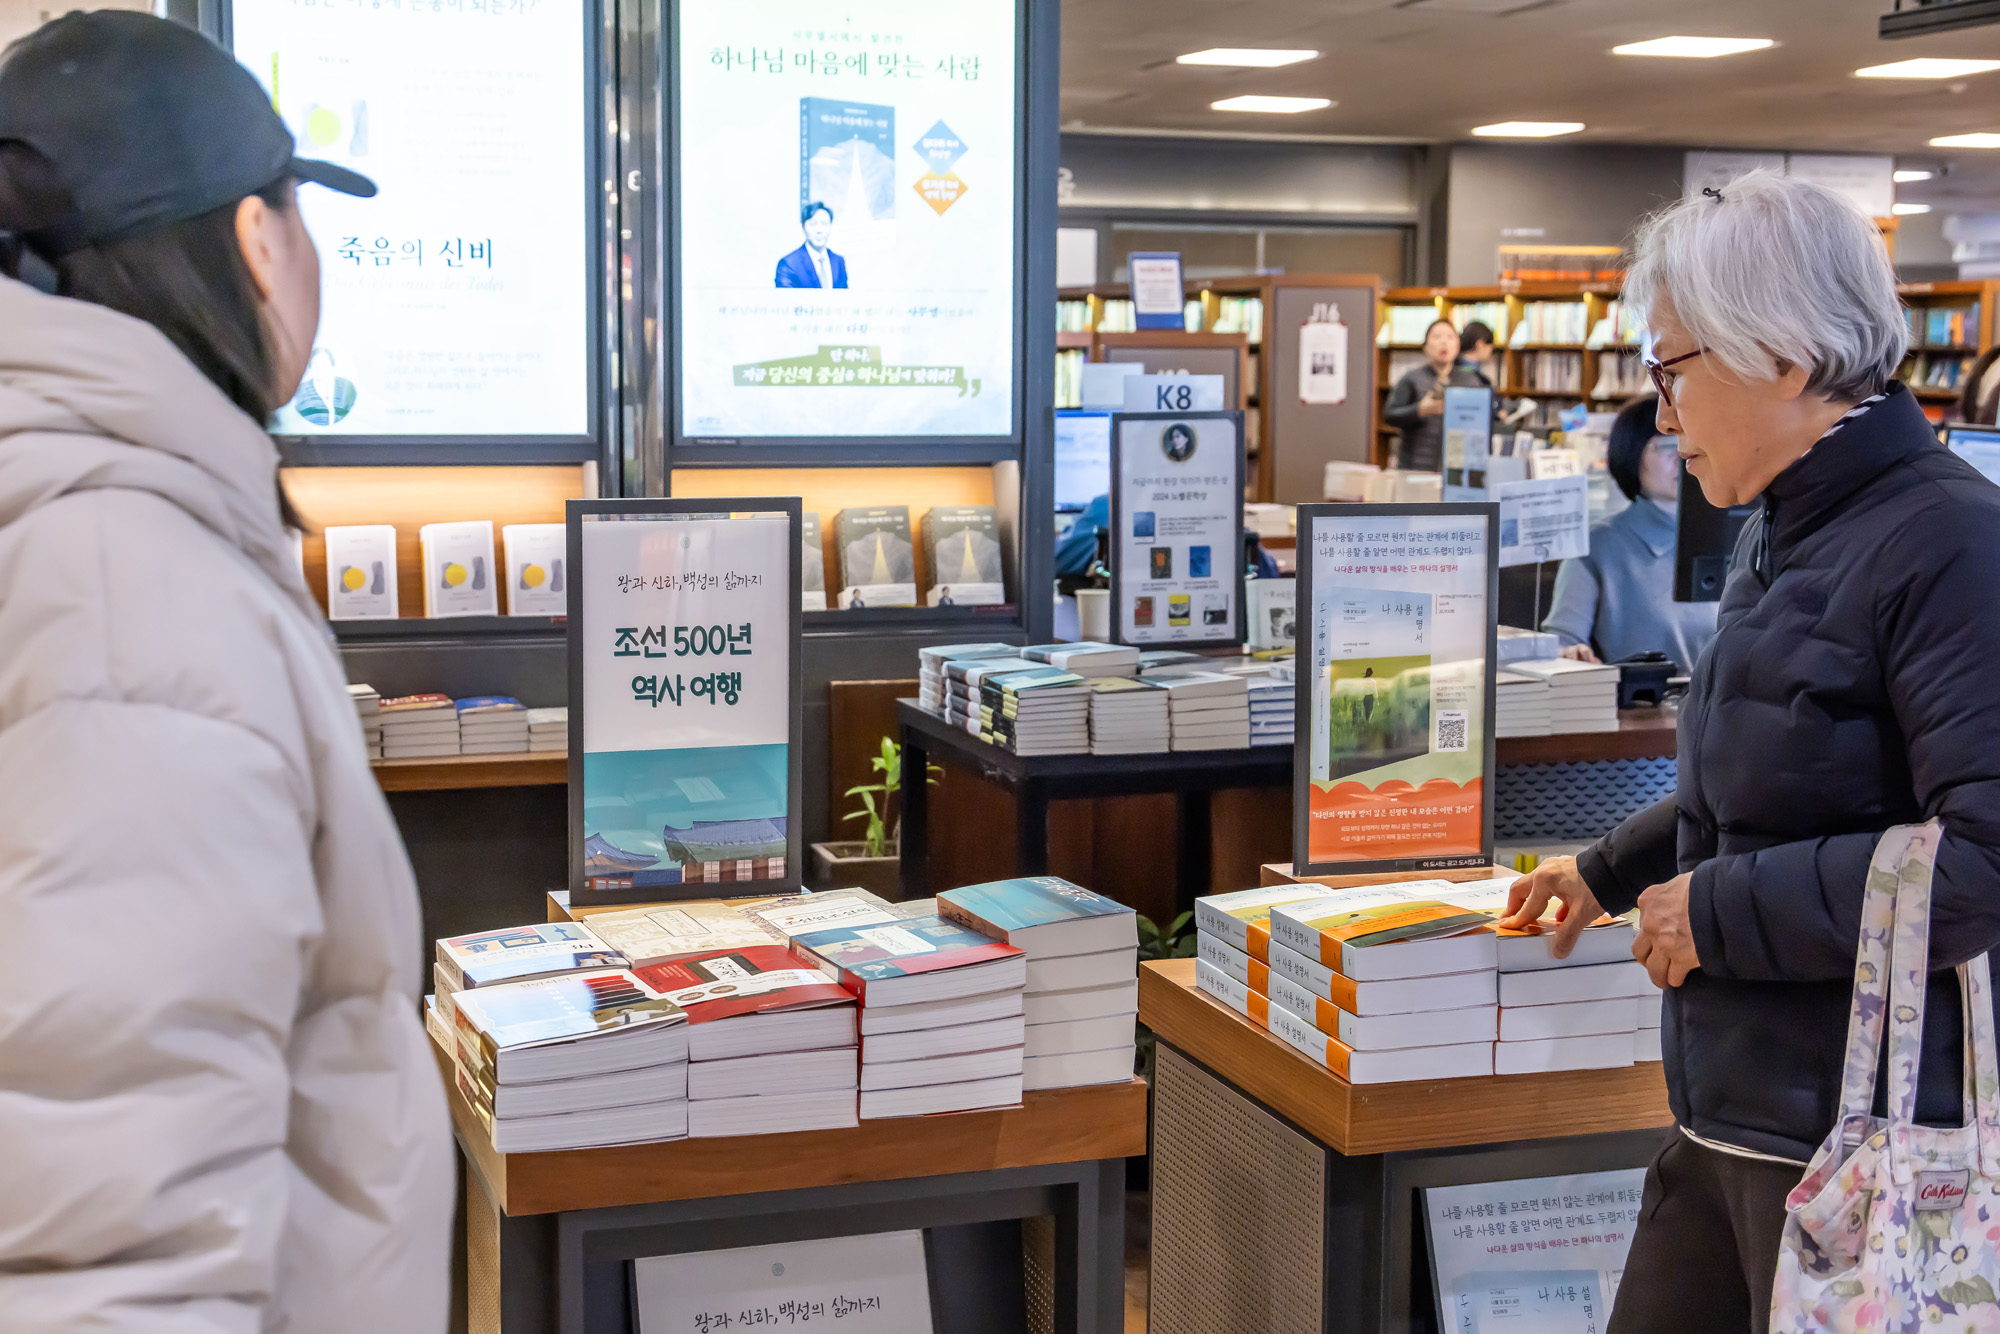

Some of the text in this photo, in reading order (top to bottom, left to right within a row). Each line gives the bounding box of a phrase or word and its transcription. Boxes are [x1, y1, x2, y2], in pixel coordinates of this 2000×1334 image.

[709, 45, 983, 81] 하나님 마음에 맞는 사람
[337, 236, 493, 269] 죽음의 신비
[466, 275, 505, 291] Todes
[829, 348, 843, 362] 단
[741, 367, 767, 383] 지금
[768, 365, 813, 384] 당신의
[815, 366, 855, 384] 중심을
[856, 366, 912, 385] 하나님께
[1156, 384, 1192, 410] K8
[1313, 531, 1482, 542] 나를 사용할 줄 모르면 원치 않는 관계에 휘둘리고
[1319, 545, 1475, 558] 나를 사용할 줄 알면 어떤 관계도 두렵지 않다.
[1334, 564, 1459, 573] 나다운 삶의 방식을 배우는 단 하나의 설명서
[617, 574, 648, 593] 왕과
[723, 570, 763, 591] 삶까지
[1381, 602, 1424, 644] 나 사용 설명서
[613, 622, 753, 658] 조선 500년
[631, 671, 742, 708] 역사 여행
[1337, 809, 1357, 819] 영향을
[1358, 809, 1372, 818] 받지
[1373, 808, 1387, 818] 않은
[1389, 807, 1409, 817] 진정한
[1409, 807, 1417, 815] 내
[1418, 806, 1438, 816] 모습은
[1440, 806, 1453, 815] 어떤
[1458, 858, 1485, 866] 도서입니다
[1200, 914, 1230, 934] 나 사용 설명서
[1275, 923, 1309, 947] 나 사용 설명서
[1207, 945, 1217, 957] 사용
[1275, 954, 1310, 980] 나 사용 설명서
[1276, 985, 1310, 1013] 나 사용 설명서
[1273, 1016, 1307, 1044] 나 사용 설명서
[1921, 1183, 1938, 1200] Cath
[1441, 1192, 1615, 1219] 나를 사용할 줄 모르면 원치 않는 관계에
[1453, 1210, 1626, 1239] 나를 사용할 줄 알면 어떤 관계도 두렵지
[1487, 1233, 1625, 1254] 나다운 삶의 방식을 배우는 단 하나의 설명서
[1538, 1286, 1550, 1302] 나
[1554, 1285, 1577, 1302] 사용
[694, 1312, 732, 1334] 왕과
[831, 1295, 881, 1319] 삶까지
